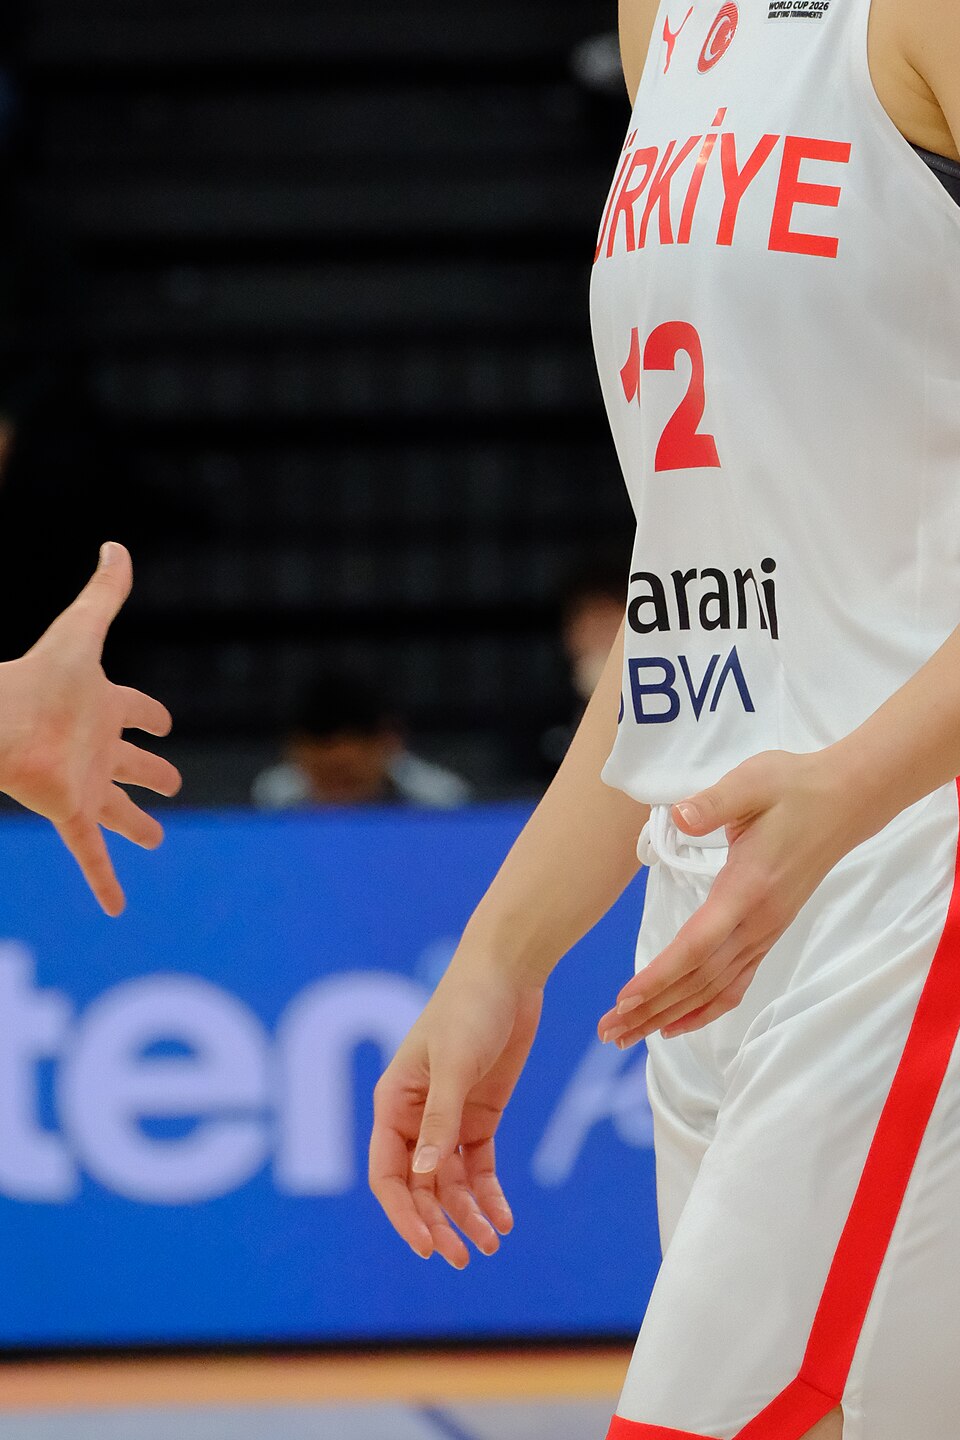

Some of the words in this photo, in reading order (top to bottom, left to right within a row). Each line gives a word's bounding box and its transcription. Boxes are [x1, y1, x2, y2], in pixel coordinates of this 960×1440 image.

[768, 1, 793, 10] WORLD
[793, 1, 809, 10] CUP
[809, 2, 830, 11] 2026
[620, 321, 721, 472] 12
[618, 645, 755, 724] BVA
